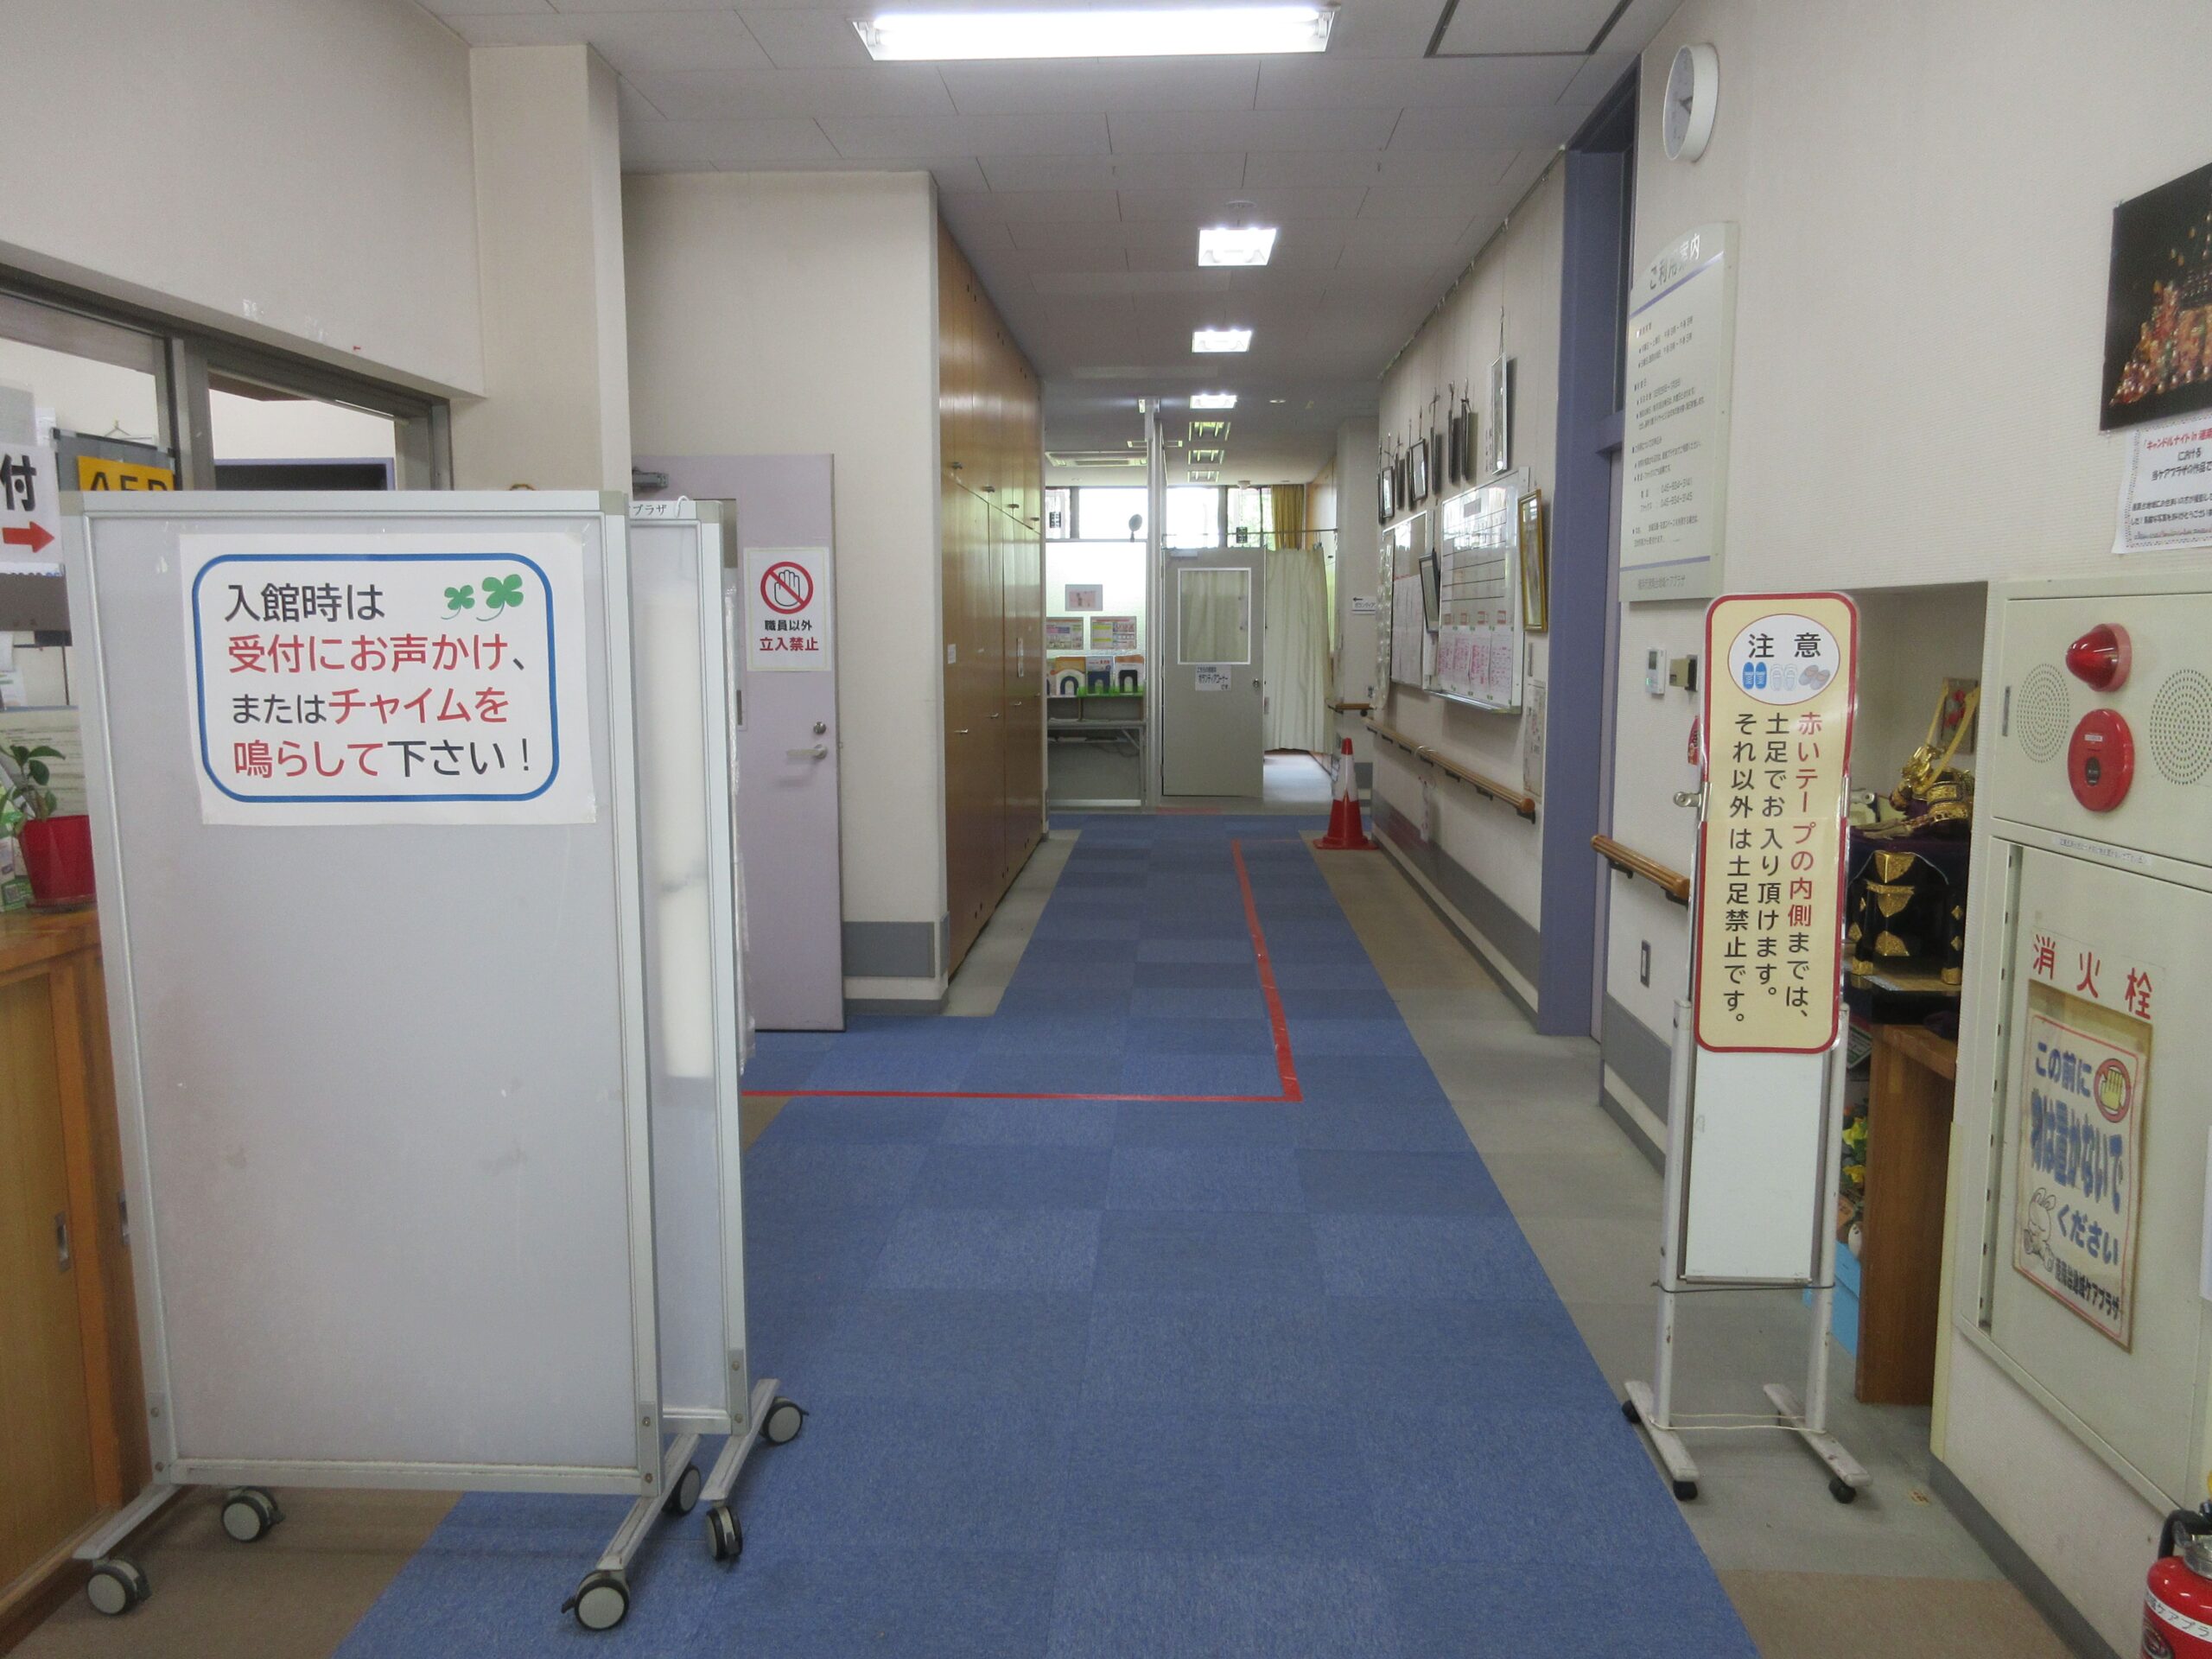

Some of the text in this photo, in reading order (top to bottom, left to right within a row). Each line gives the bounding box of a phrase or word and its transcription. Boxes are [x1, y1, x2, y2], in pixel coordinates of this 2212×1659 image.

[0, 454, 37, 512] 付
[628, 504, 667, 517] プラザ
[225, 583, 385, 623] 入館時は
[765, 620, 812, 632] 職員以外
[228, 633, 525, 673] 受付にお声かけ、
[760, 637, 819, 652] 立入禁止
[232, 687, 509, 725] またはチャイムを
[1723, 714, 1757, 1022] それ以外は土足禁止です。
[1756, 713, 1789, 995] 土足でお入り頂けます。
[1786, 711, 1822, 1018] 赤いテープの内側までは、
[2033, 934, 2152, 1020] 消火栓
[2036, 1042, 2092, 1097] この前に
[2057, 1205, 2120, 1266] ください
